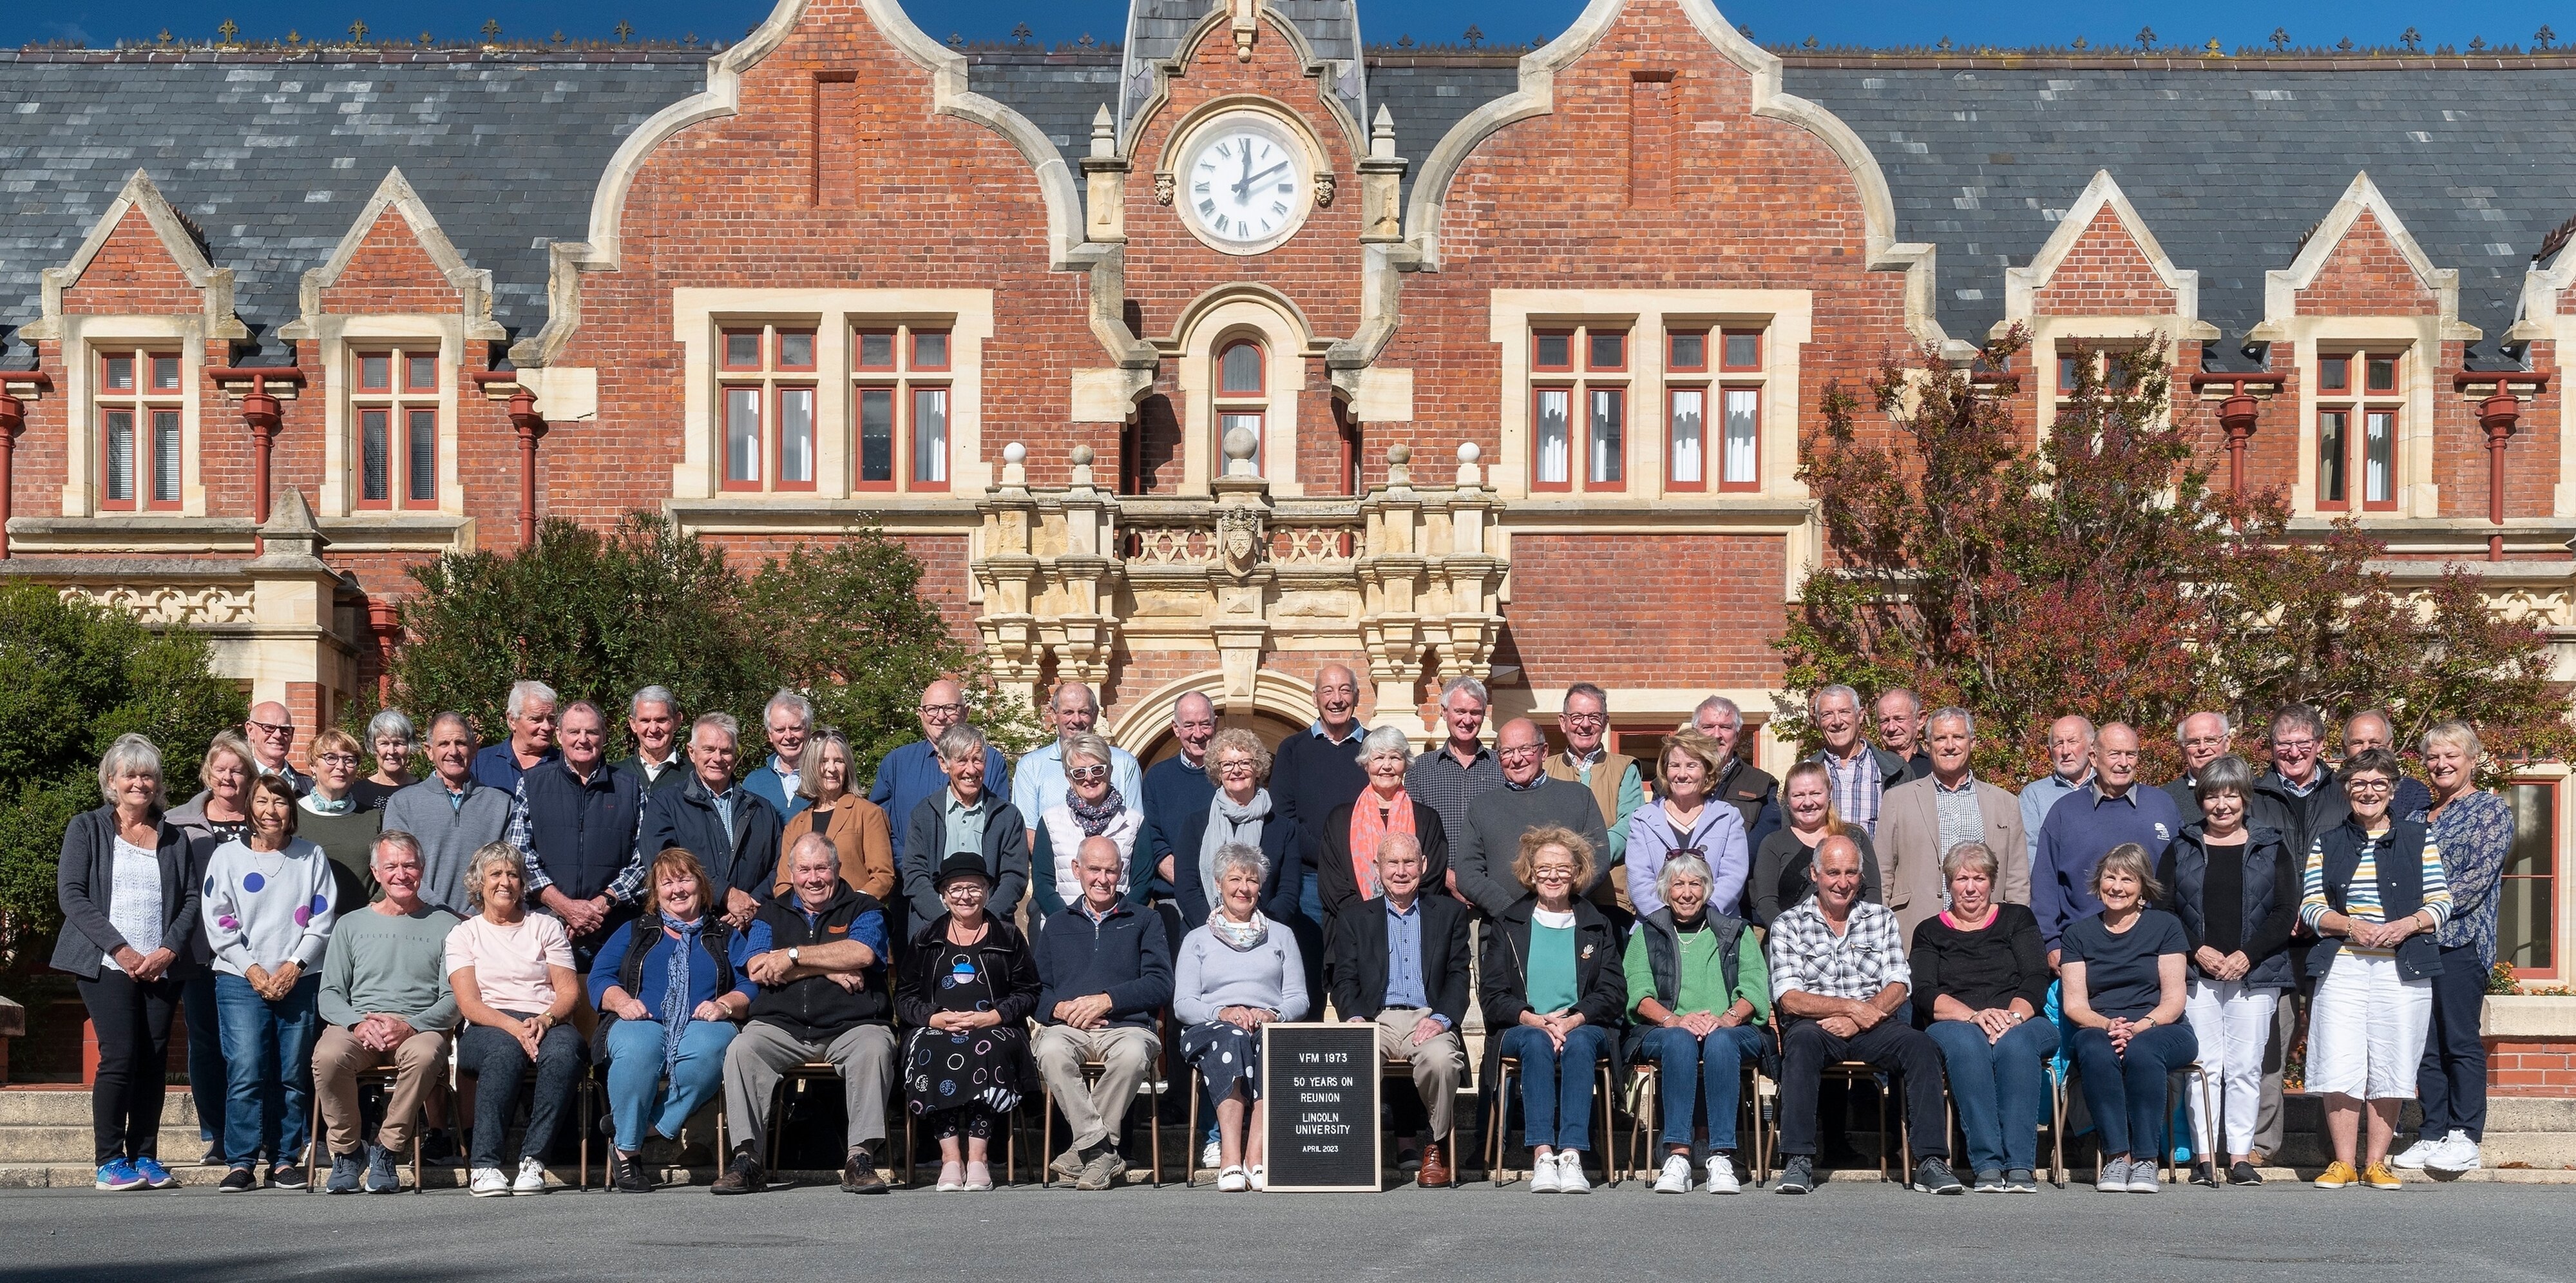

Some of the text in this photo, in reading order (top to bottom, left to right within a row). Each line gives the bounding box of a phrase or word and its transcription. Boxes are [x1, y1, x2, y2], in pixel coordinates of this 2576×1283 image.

[1225, 650, 1253, 662] 1878
[406, 934, 430, 943] LAKE
[1299, 1053, 1348, 1063] VFM 1973
[1293, 1077, 1353, 1087] 50 YEARS ON
[1301, 1093, 1340, 1103] REUNION
[1302, 1113, 1339, 1123] LINCOLN
[1295, 1125, 1350, 1134] UNIVERSITY
